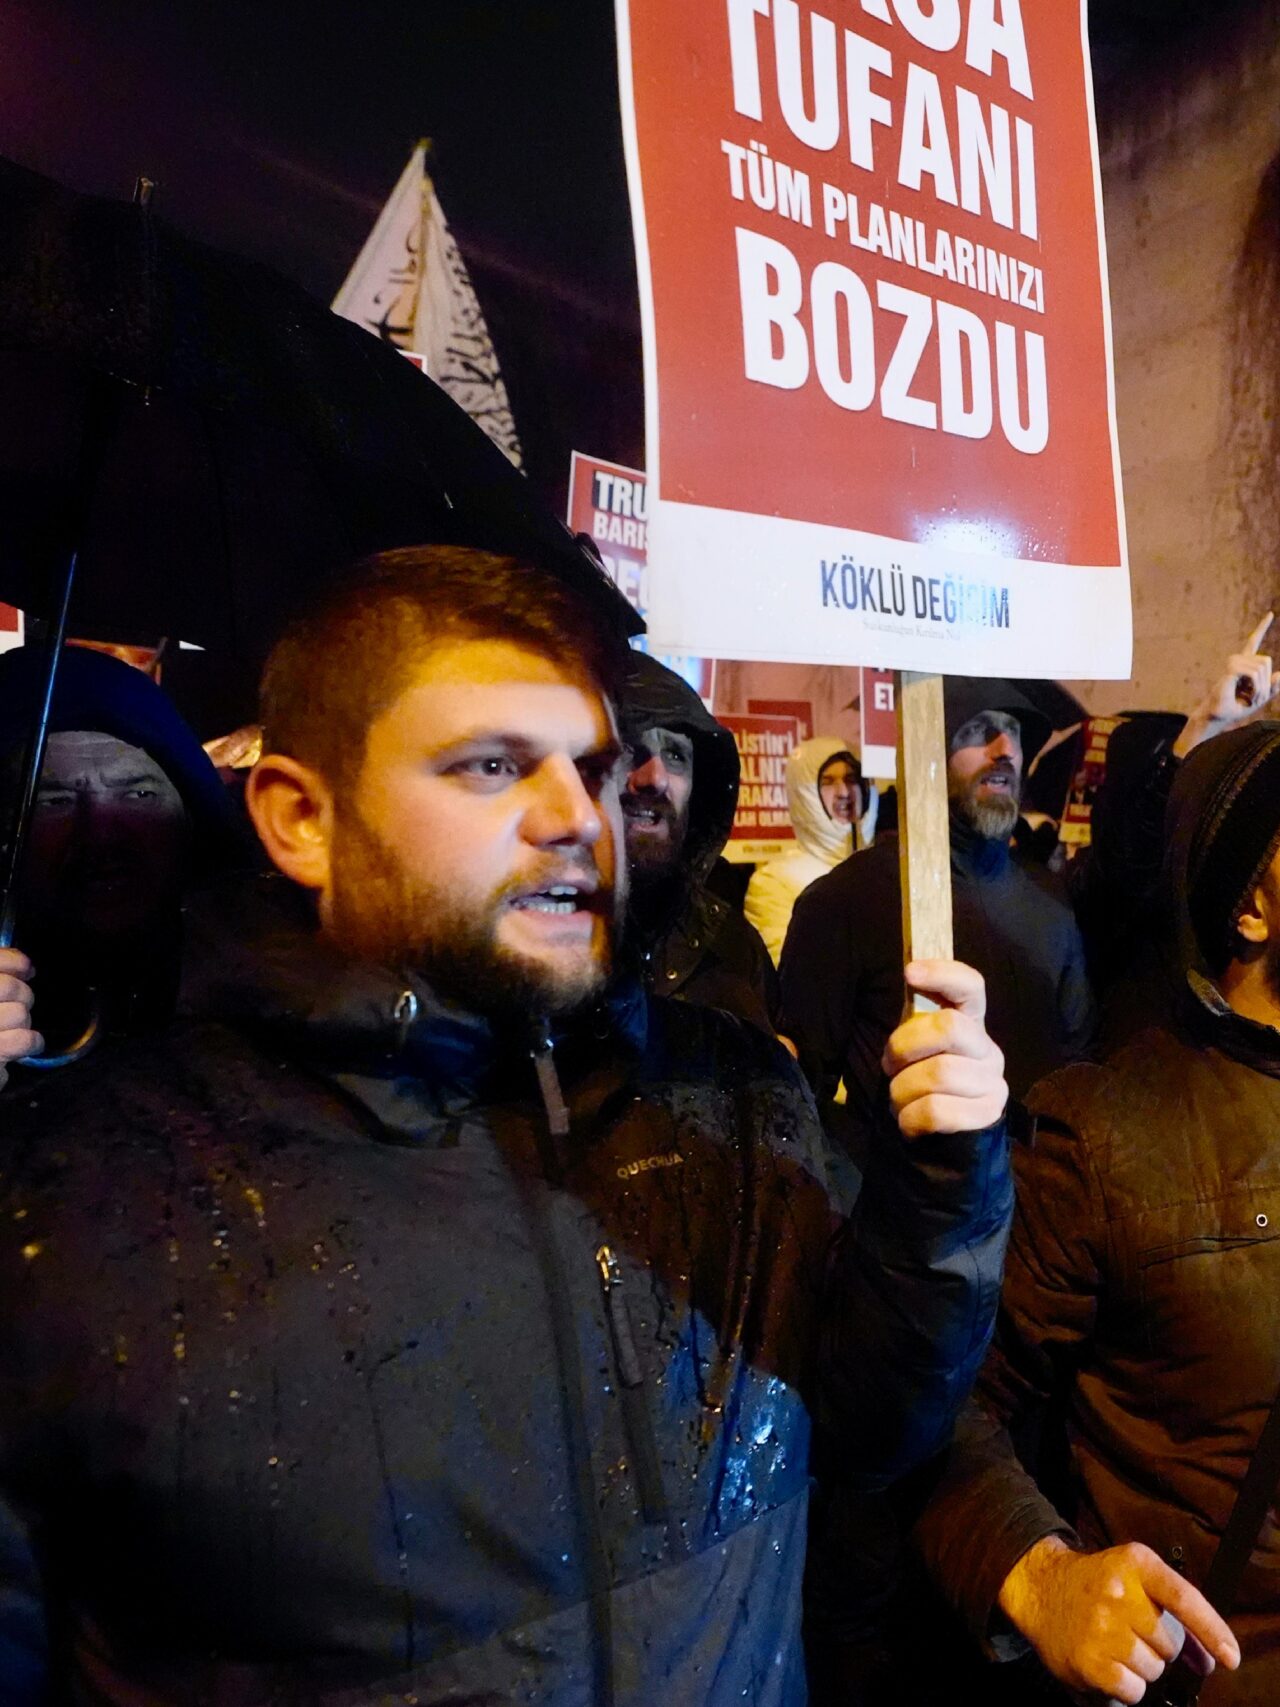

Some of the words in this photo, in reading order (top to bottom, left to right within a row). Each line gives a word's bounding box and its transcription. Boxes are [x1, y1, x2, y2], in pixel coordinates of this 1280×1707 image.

[721, 140, 812, 228] TÜM
[823, 182, 1045, 314] PLANLARINIZI
[735, 227, 1049, 455] BOZDU
[595, 469, 648, 523] TRU
[820, 555, 905, 617] KÖKLÜ
[617, 1153, 684, 1180] QUECHUA
